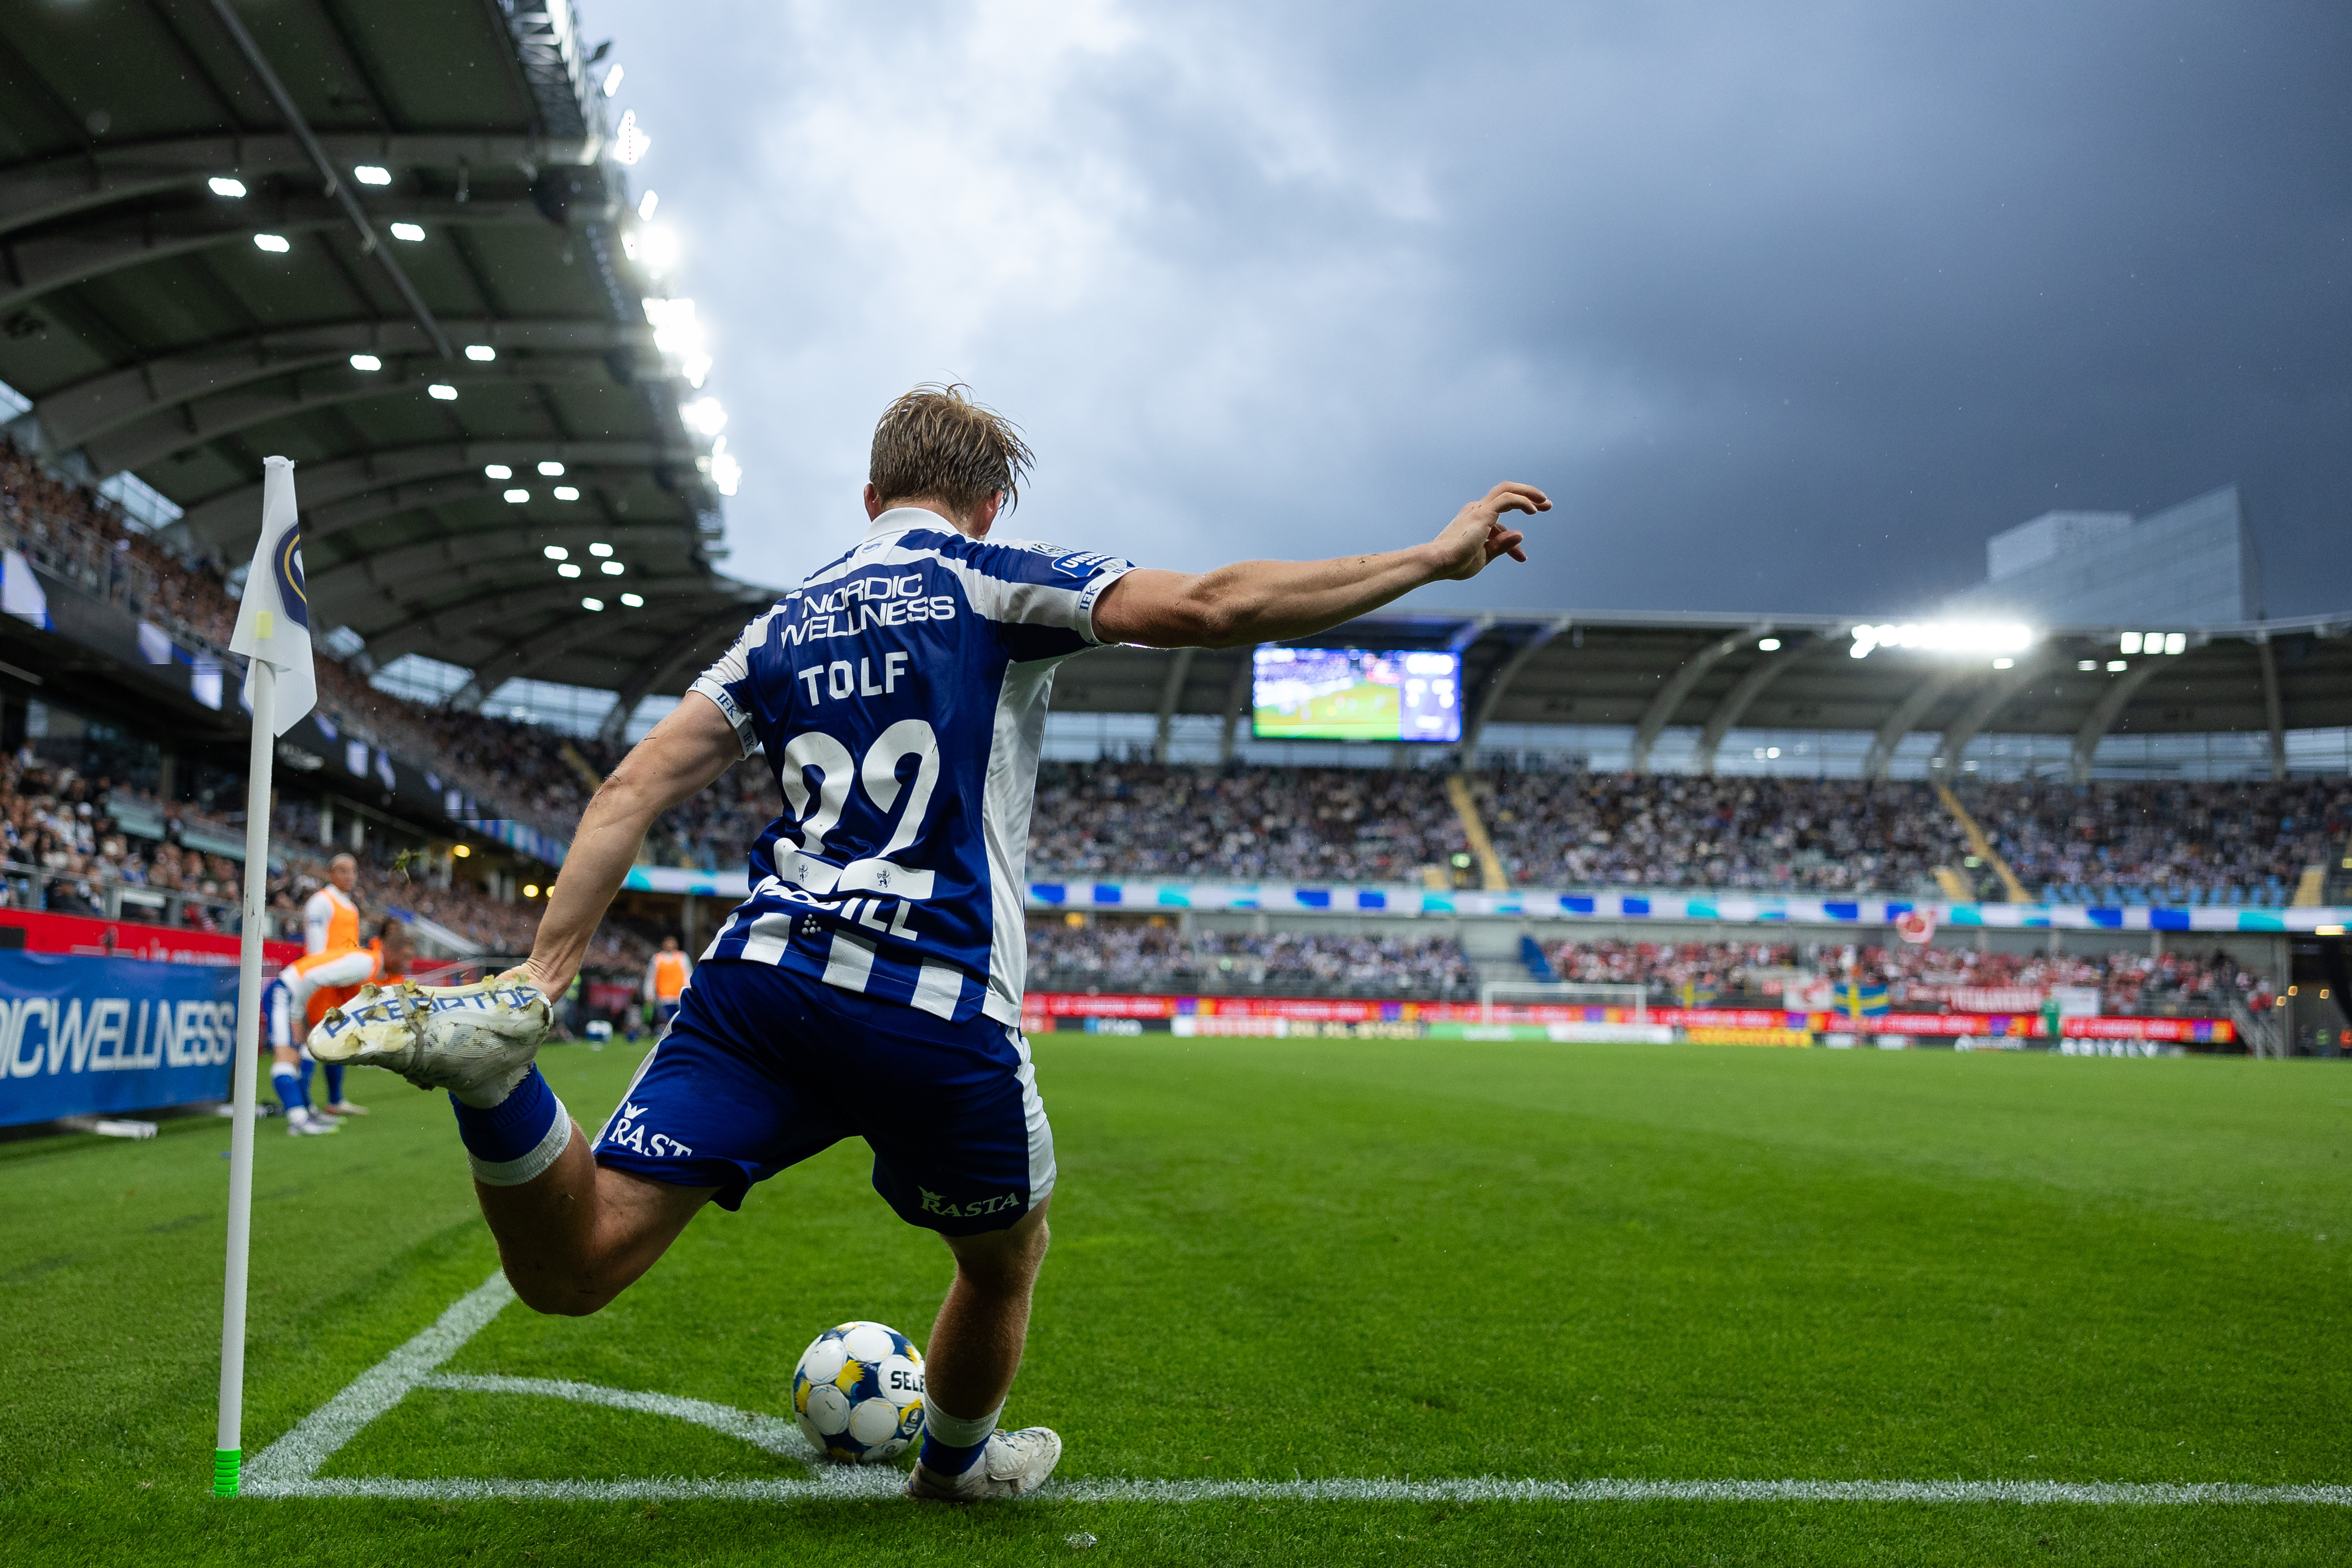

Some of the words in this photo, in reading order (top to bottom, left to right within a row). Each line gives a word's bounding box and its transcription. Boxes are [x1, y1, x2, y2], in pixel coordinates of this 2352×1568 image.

[1061, 552, 1104, 568] UNIB
[802, 573, 922, 618] NORDIC
[1079, 585, 1100, 611] IFK
[781, 596, 956, 649] WELLNESS
[798, 651, 908, 706] TOLF
[716, 692, 738, 719] IFK
[743, 731, 754, 752] IFK
[773, 719, 940, 899] 22
[920, 1192, 1020, 1216] RASTA
